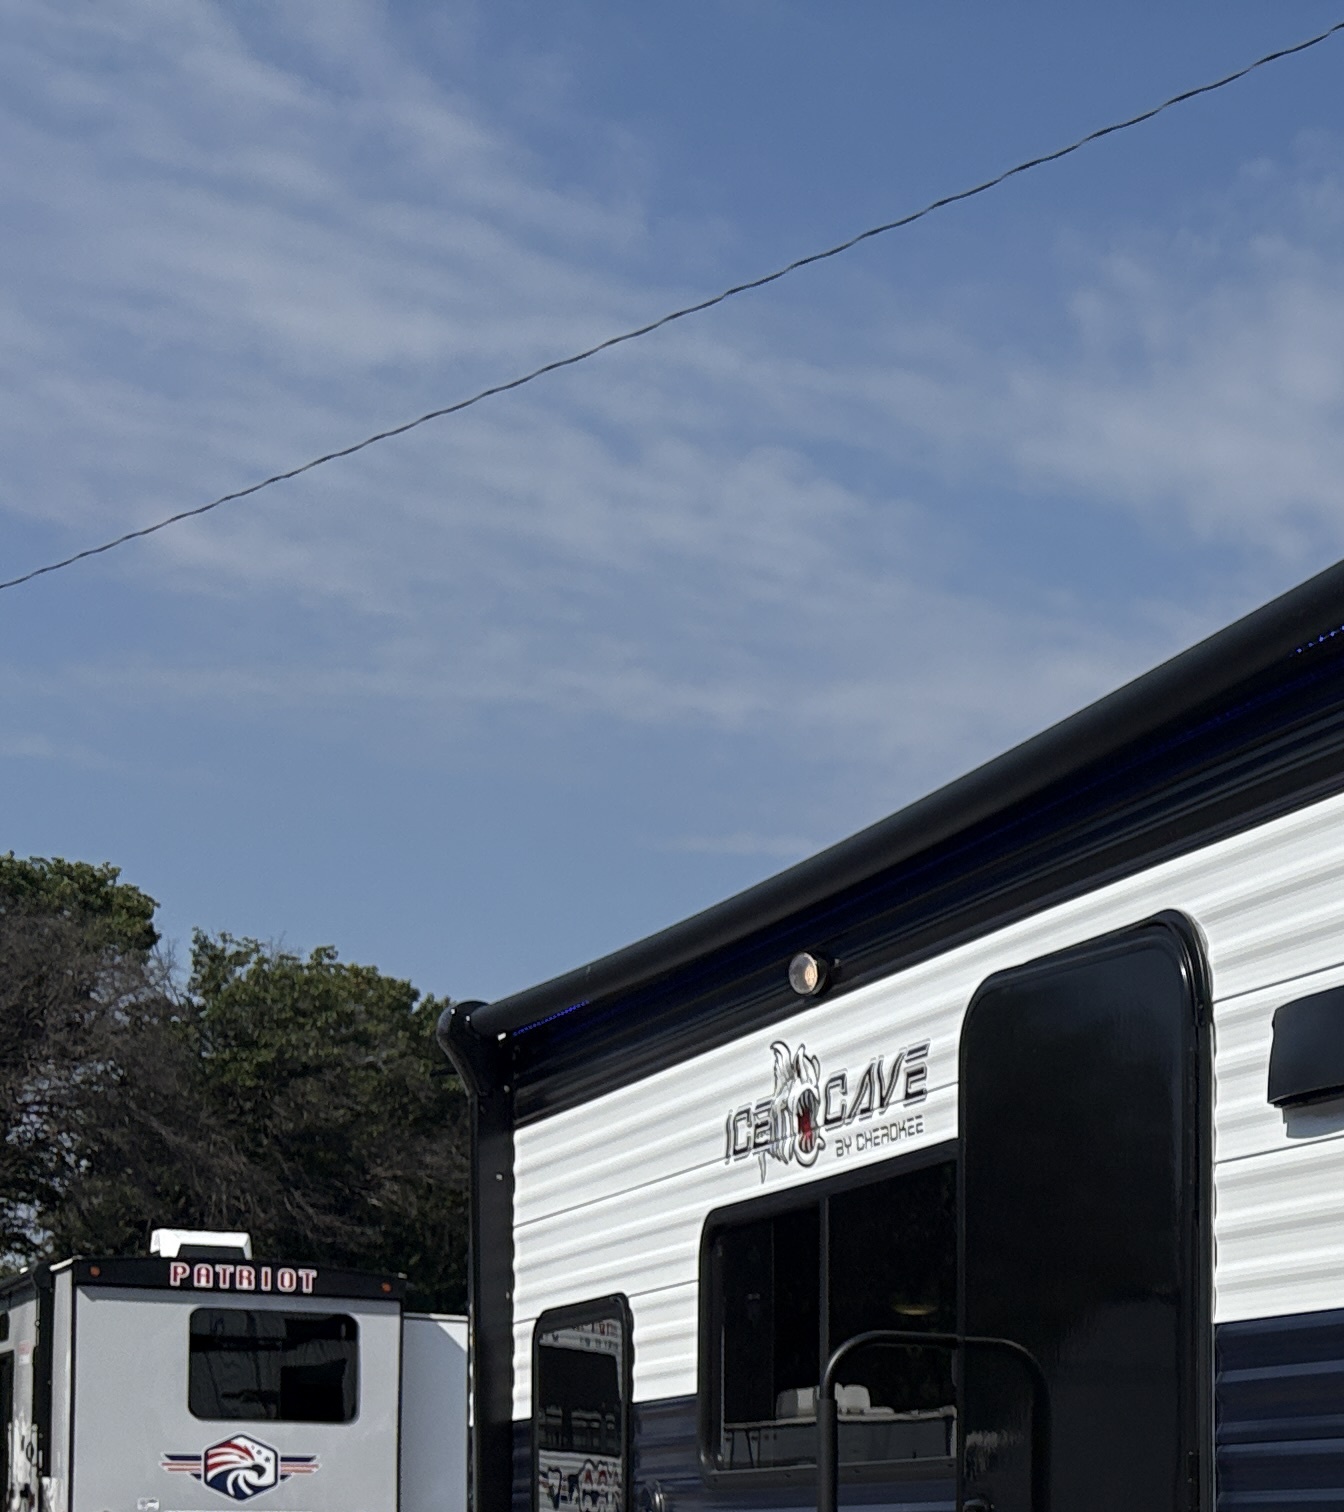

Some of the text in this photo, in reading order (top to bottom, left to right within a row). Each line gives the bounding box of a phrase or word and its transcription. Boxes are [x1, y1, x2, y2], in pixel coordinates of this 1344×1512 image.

[724, 1038, 931, 1165] ICE CAVE
[835, 1115, 925, 1158] BY CHEROKEE
[169, 1261, 317, 1294] PATRIOT
